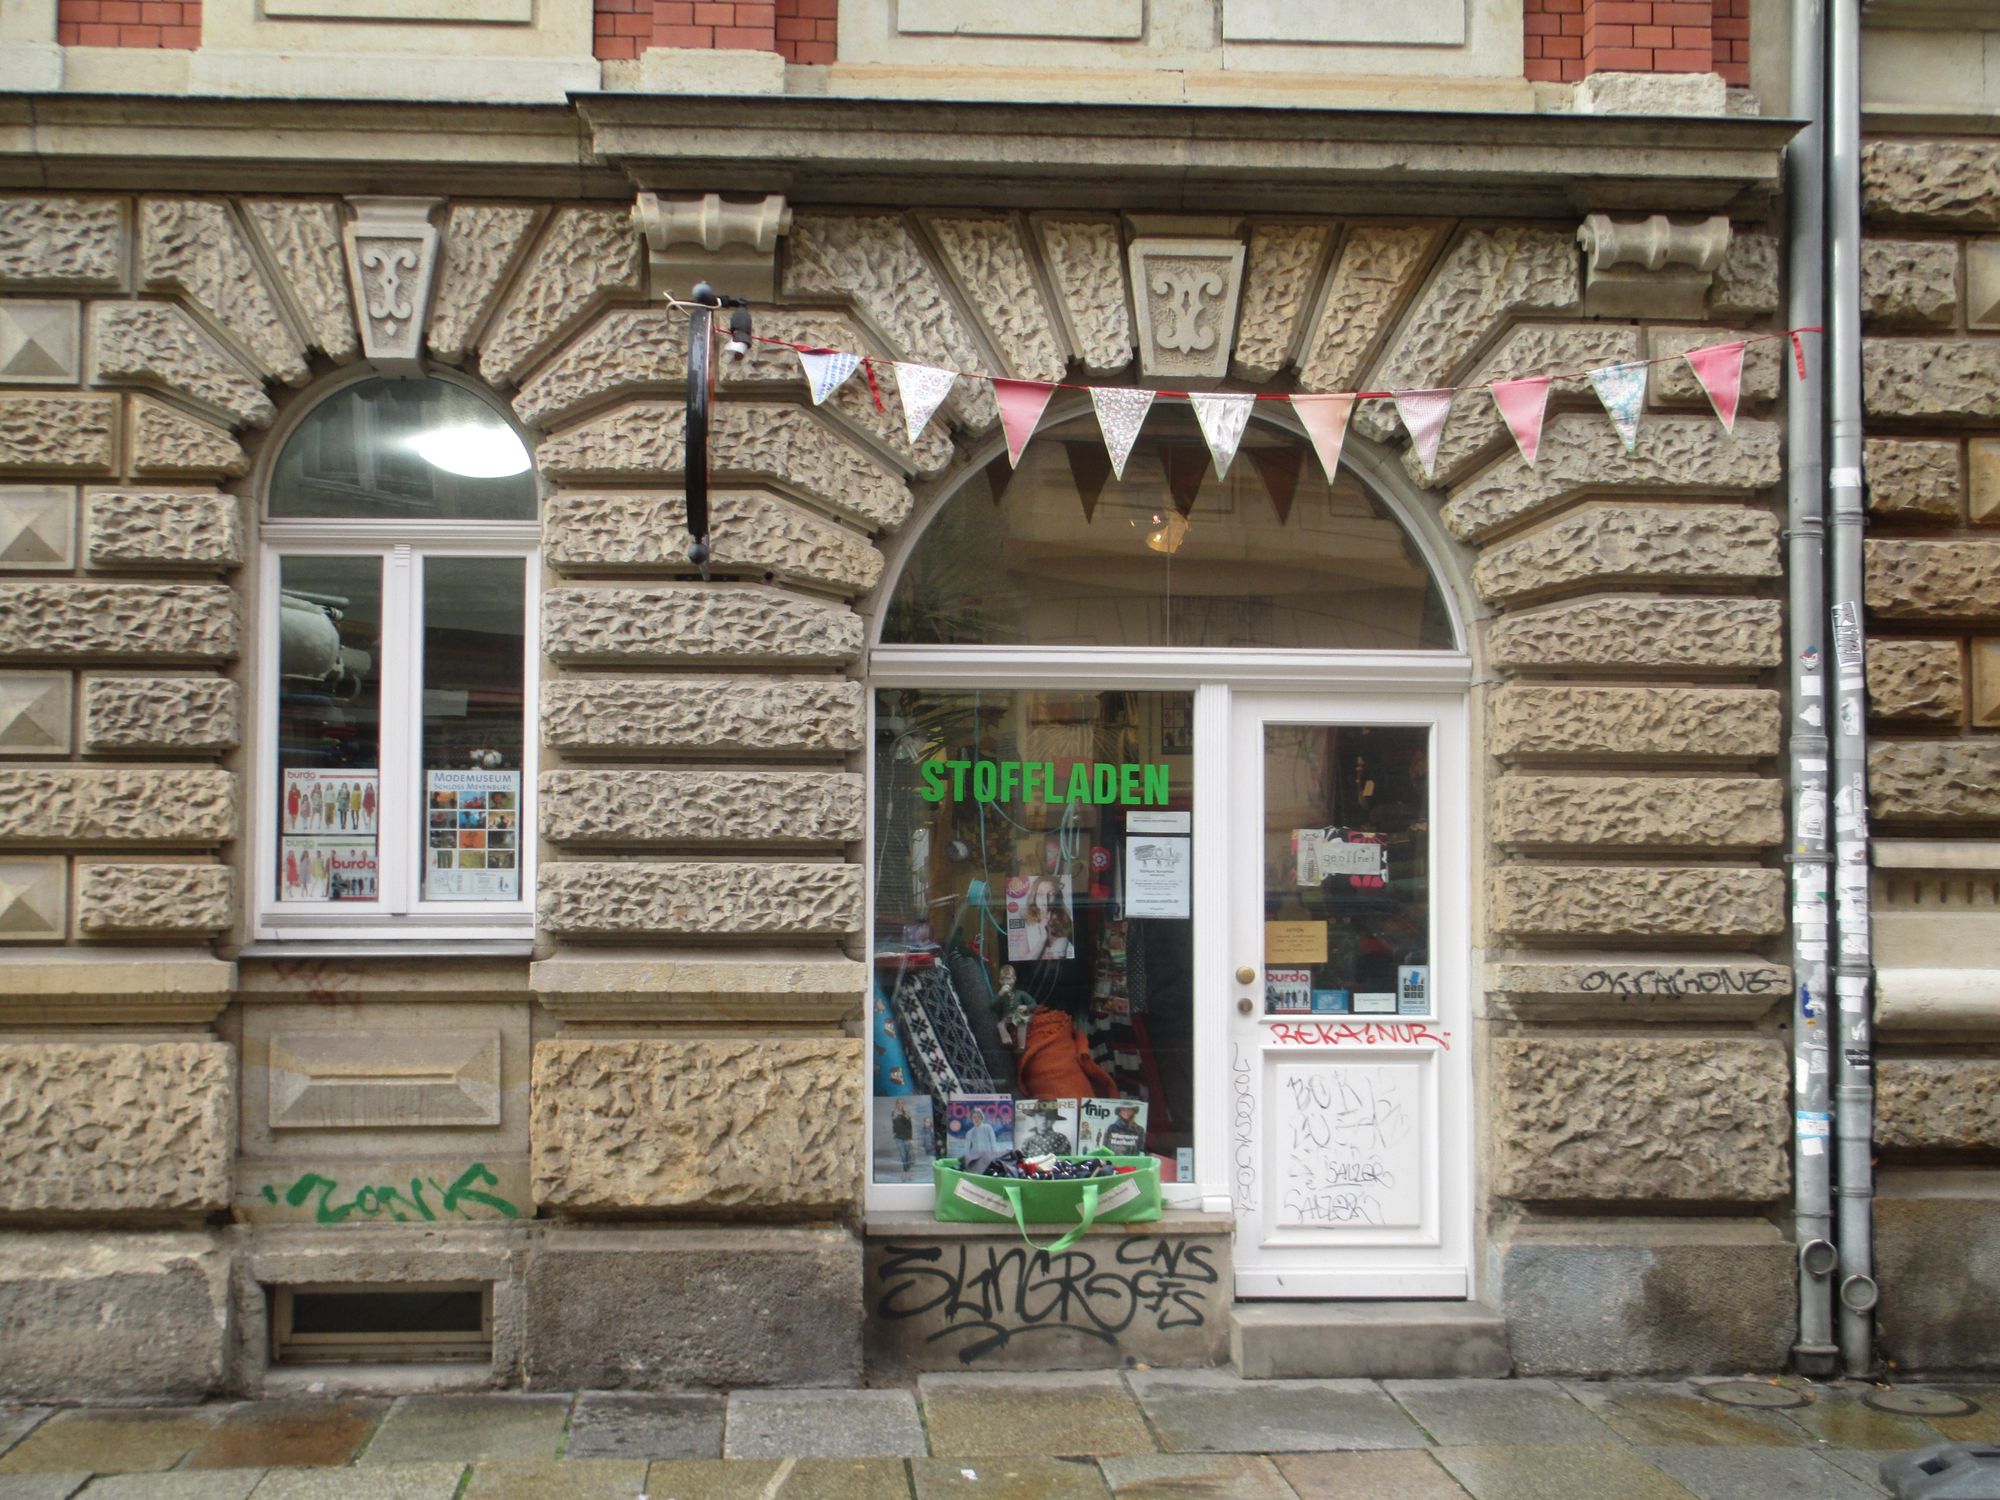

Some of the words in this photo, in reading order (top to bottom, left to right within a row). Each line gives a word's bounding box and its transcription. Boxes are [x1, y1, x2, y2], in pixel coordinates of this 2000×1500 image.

[287, 771, 316, 780] burda
[920, 759, 1170, 805] STOFFLADEN
[285, 839, 315, 848] burda
[331, 857, 376, 869] burda
[1266, 970, 1309, 982] burda
[950, 1103, 1013, 1119] burda
